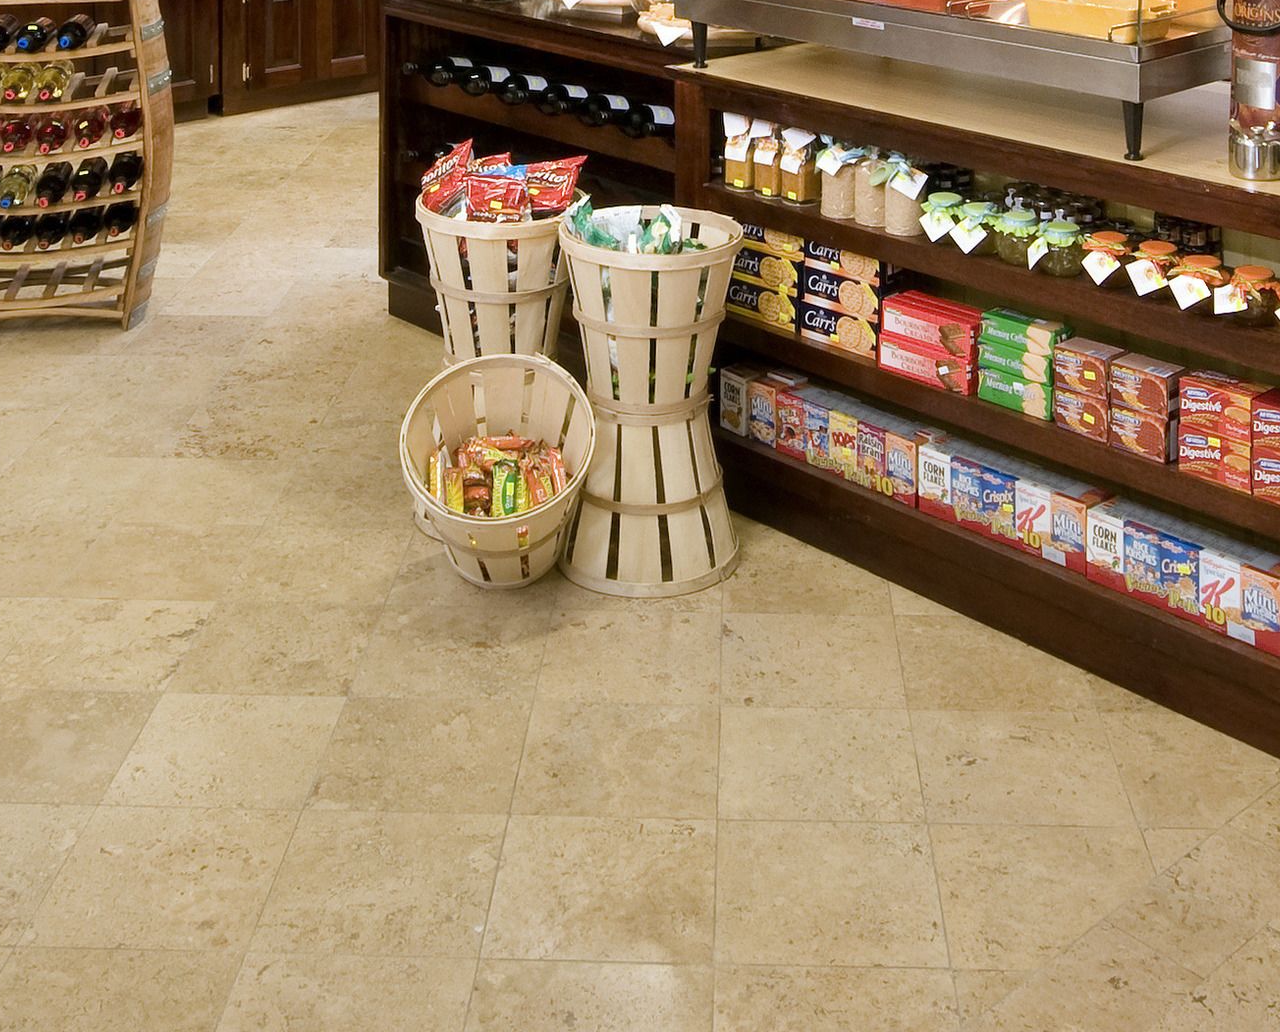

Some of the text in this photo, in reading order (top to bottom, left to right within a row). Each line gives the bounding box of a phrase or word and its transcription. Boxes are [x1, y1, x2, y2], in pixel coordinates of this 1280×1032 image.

[742, 222, 763, 237] arr's
[809, 240, 839, 261] Carr's
[729, 285, 757, 305] Carr's
[808, 274, 839, 298] Carr's
[804, 309, 836, 333] Carr's
[1181, 398, 1222, 413] Digestive
[1179, 446, 1221, 461] Digestive
[923, 460, 945, 478] CORN
[874, 474, 894, 497] 10
[923, 472, 946, 488] FLAKES
[983, 489, 1014, 506] Crispix
[1016, 504, 1046, 534] K
[1021, 527, 1041, 548] 10
[1093, 524, 1117, 543] CORN
[1092, 536, 1117, 555] FLAKES
[1201, 577, 1235, 609] K
[1205, 603, 1227, 625] 10
